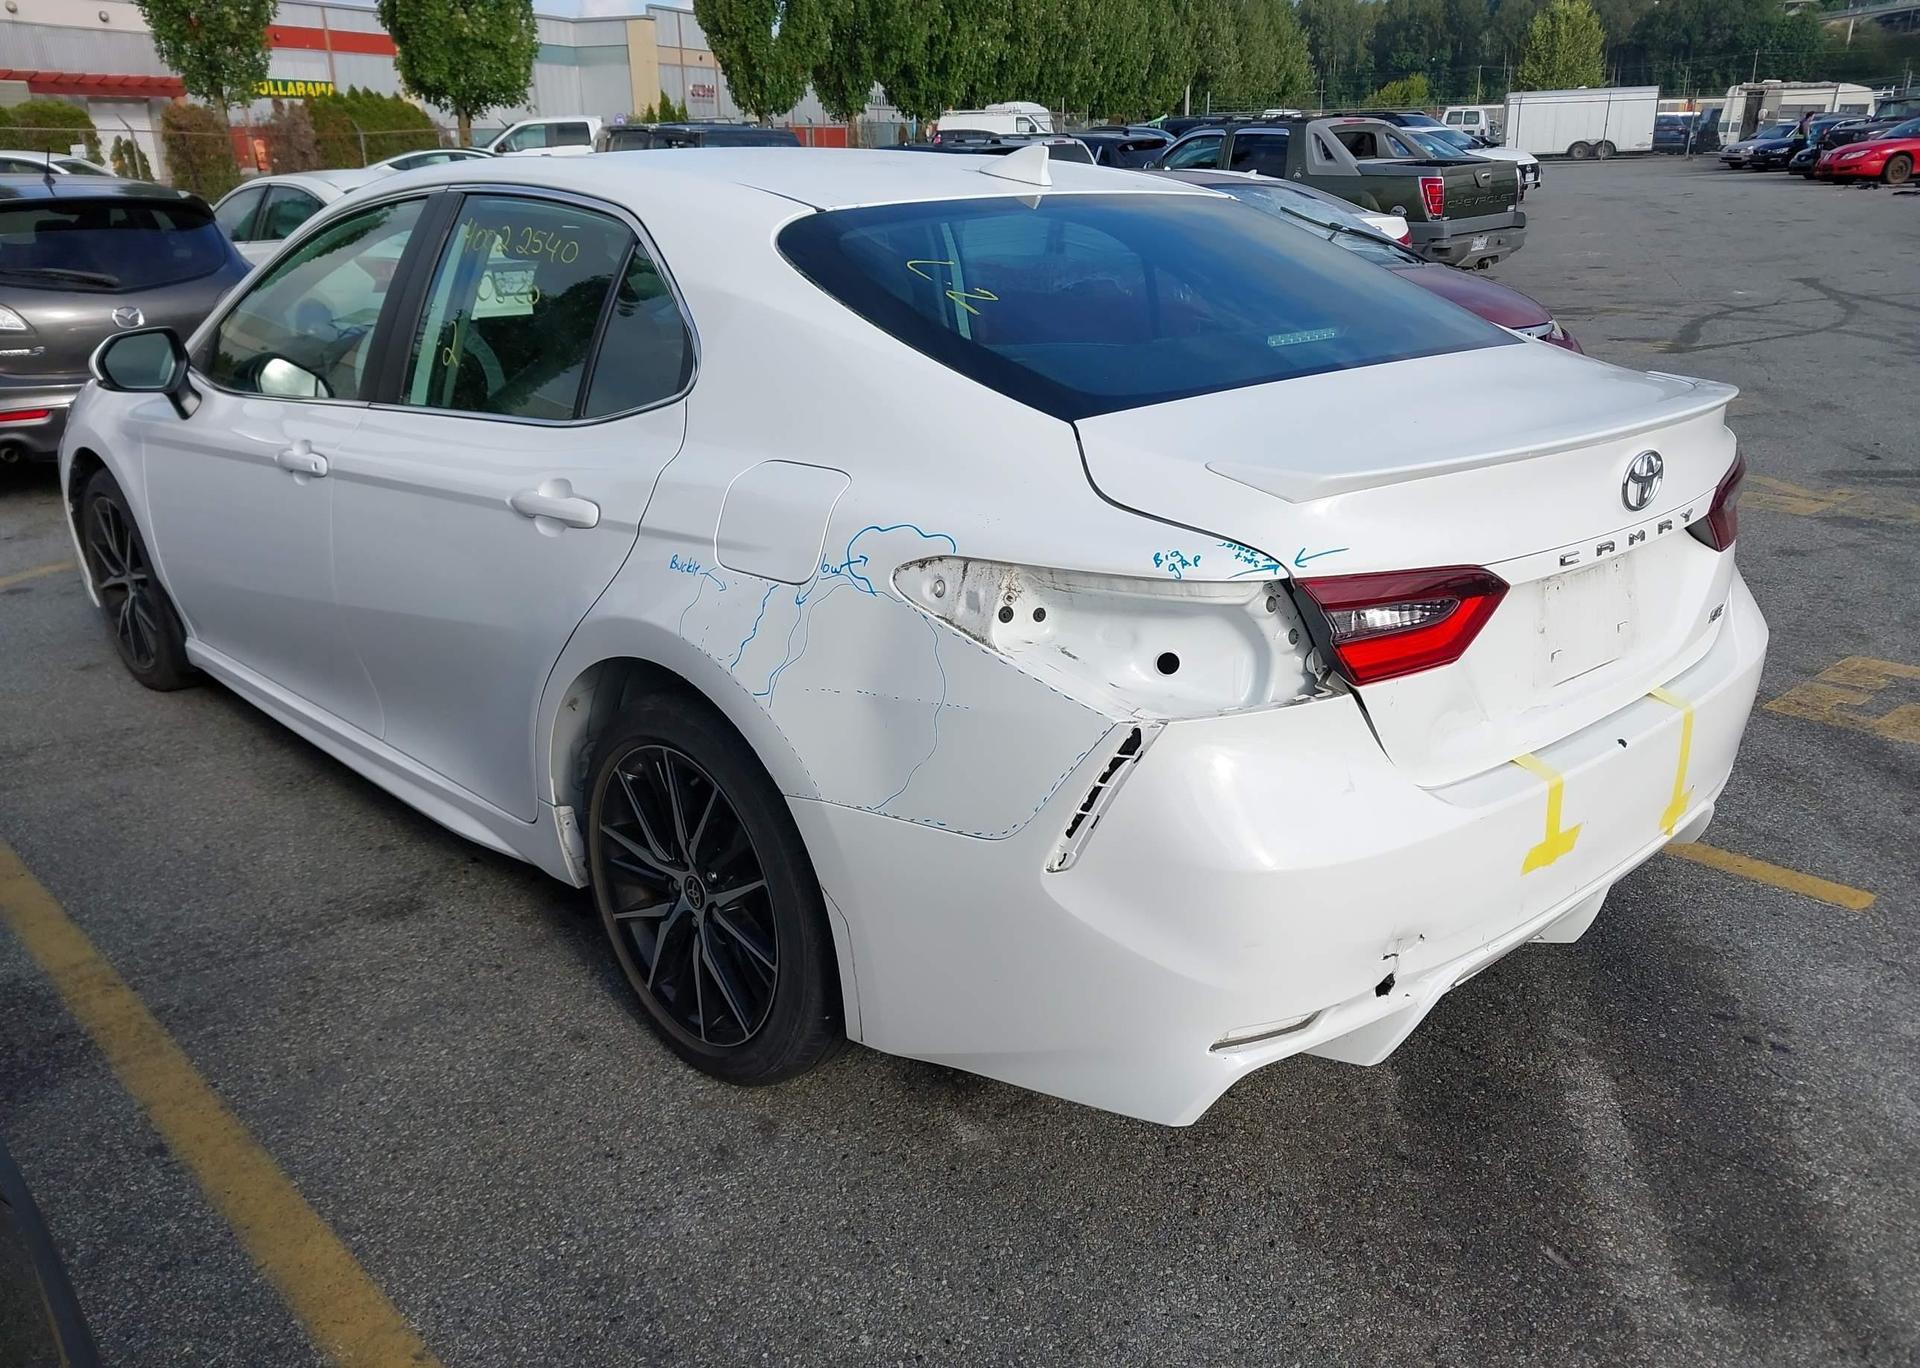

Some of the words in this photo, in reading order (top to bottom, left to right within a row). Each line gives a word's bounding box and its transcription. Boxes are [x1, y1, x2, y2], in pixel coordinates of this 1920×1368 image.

[251, 80, 336, 97] OLLARAMA
[1447, 192, 1515, 209] CHEVROLET
[1559, 508, 1694, 567] CAMRY
